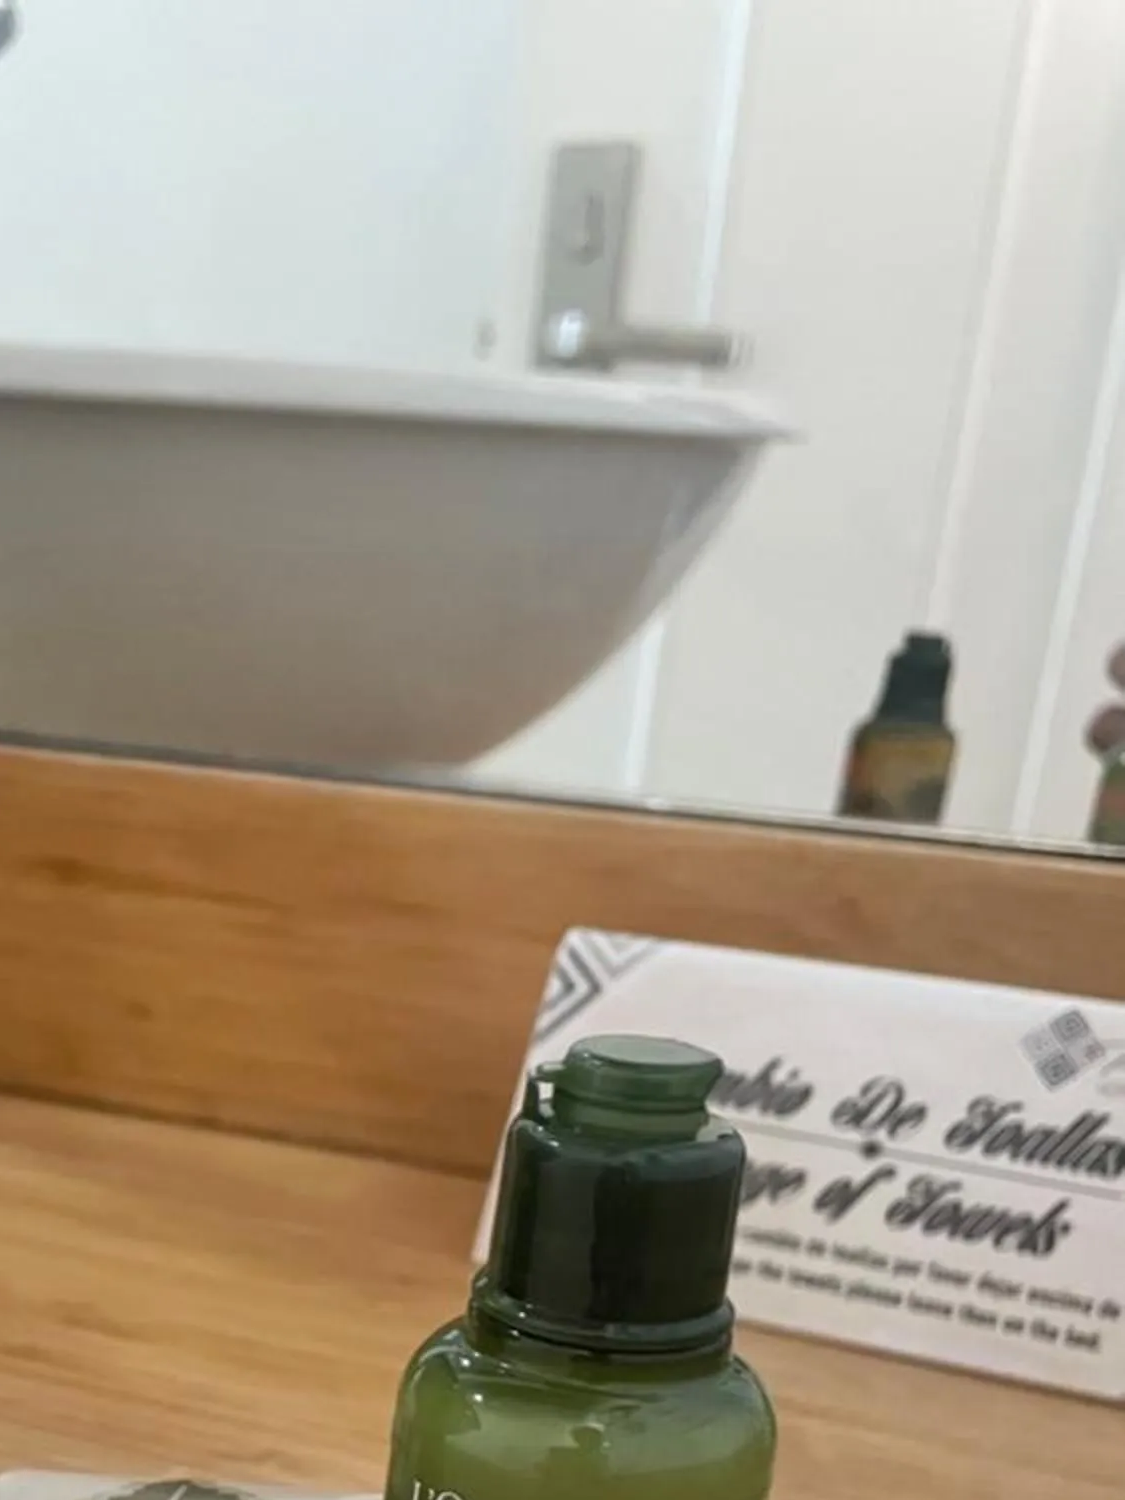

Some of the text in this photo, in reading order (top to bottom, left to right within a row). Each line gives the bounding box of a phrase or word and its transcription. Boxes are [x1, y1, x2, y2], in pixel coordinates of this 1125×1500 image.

[831, 1075, 927, 1141] De
[812, 1163, 897, 1224] of
[885, 1174, 1074, 1258] Towels
